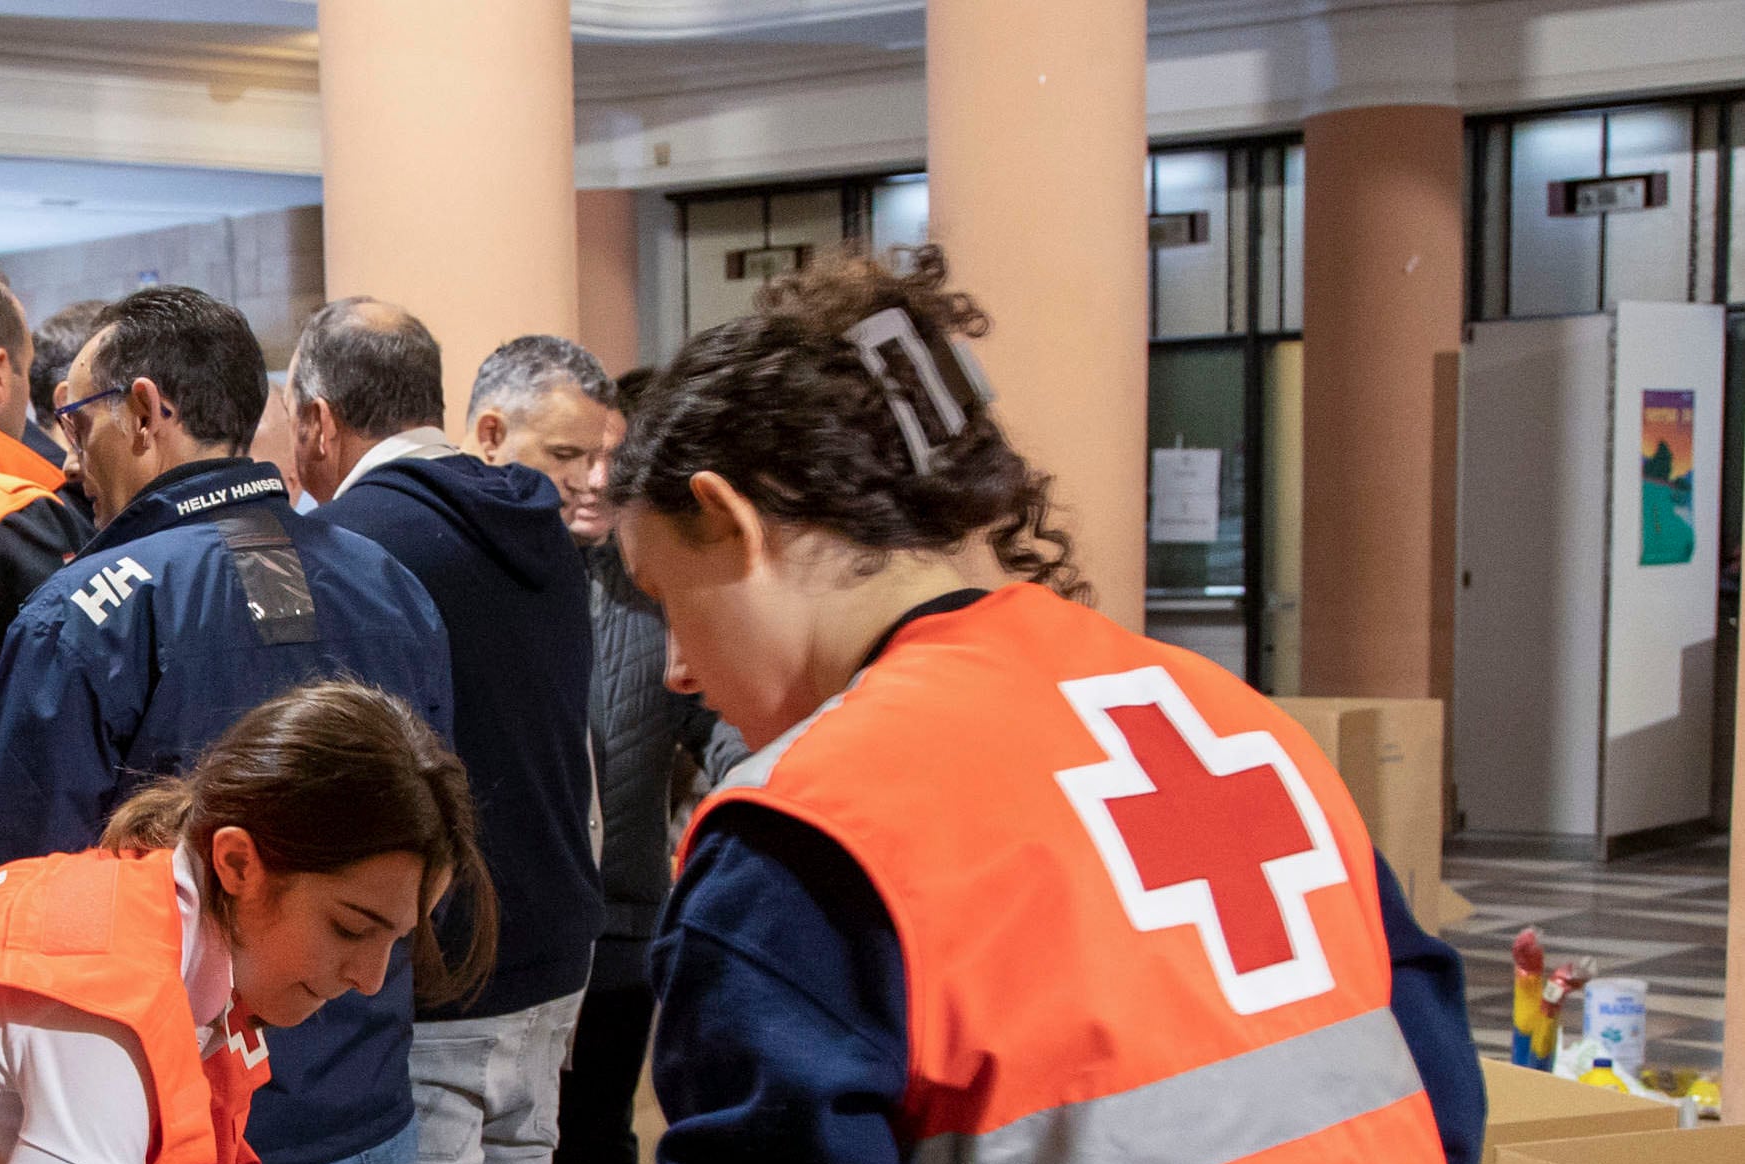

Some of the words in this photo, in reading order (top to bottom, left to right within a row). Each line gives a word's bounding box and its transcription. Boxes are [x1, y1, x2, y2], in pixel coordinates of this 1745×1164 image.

[176, 489, 228, 516] HELLY
[229, 477, 284, 499] HANSEN
[70, 556, 153, 626] HH
